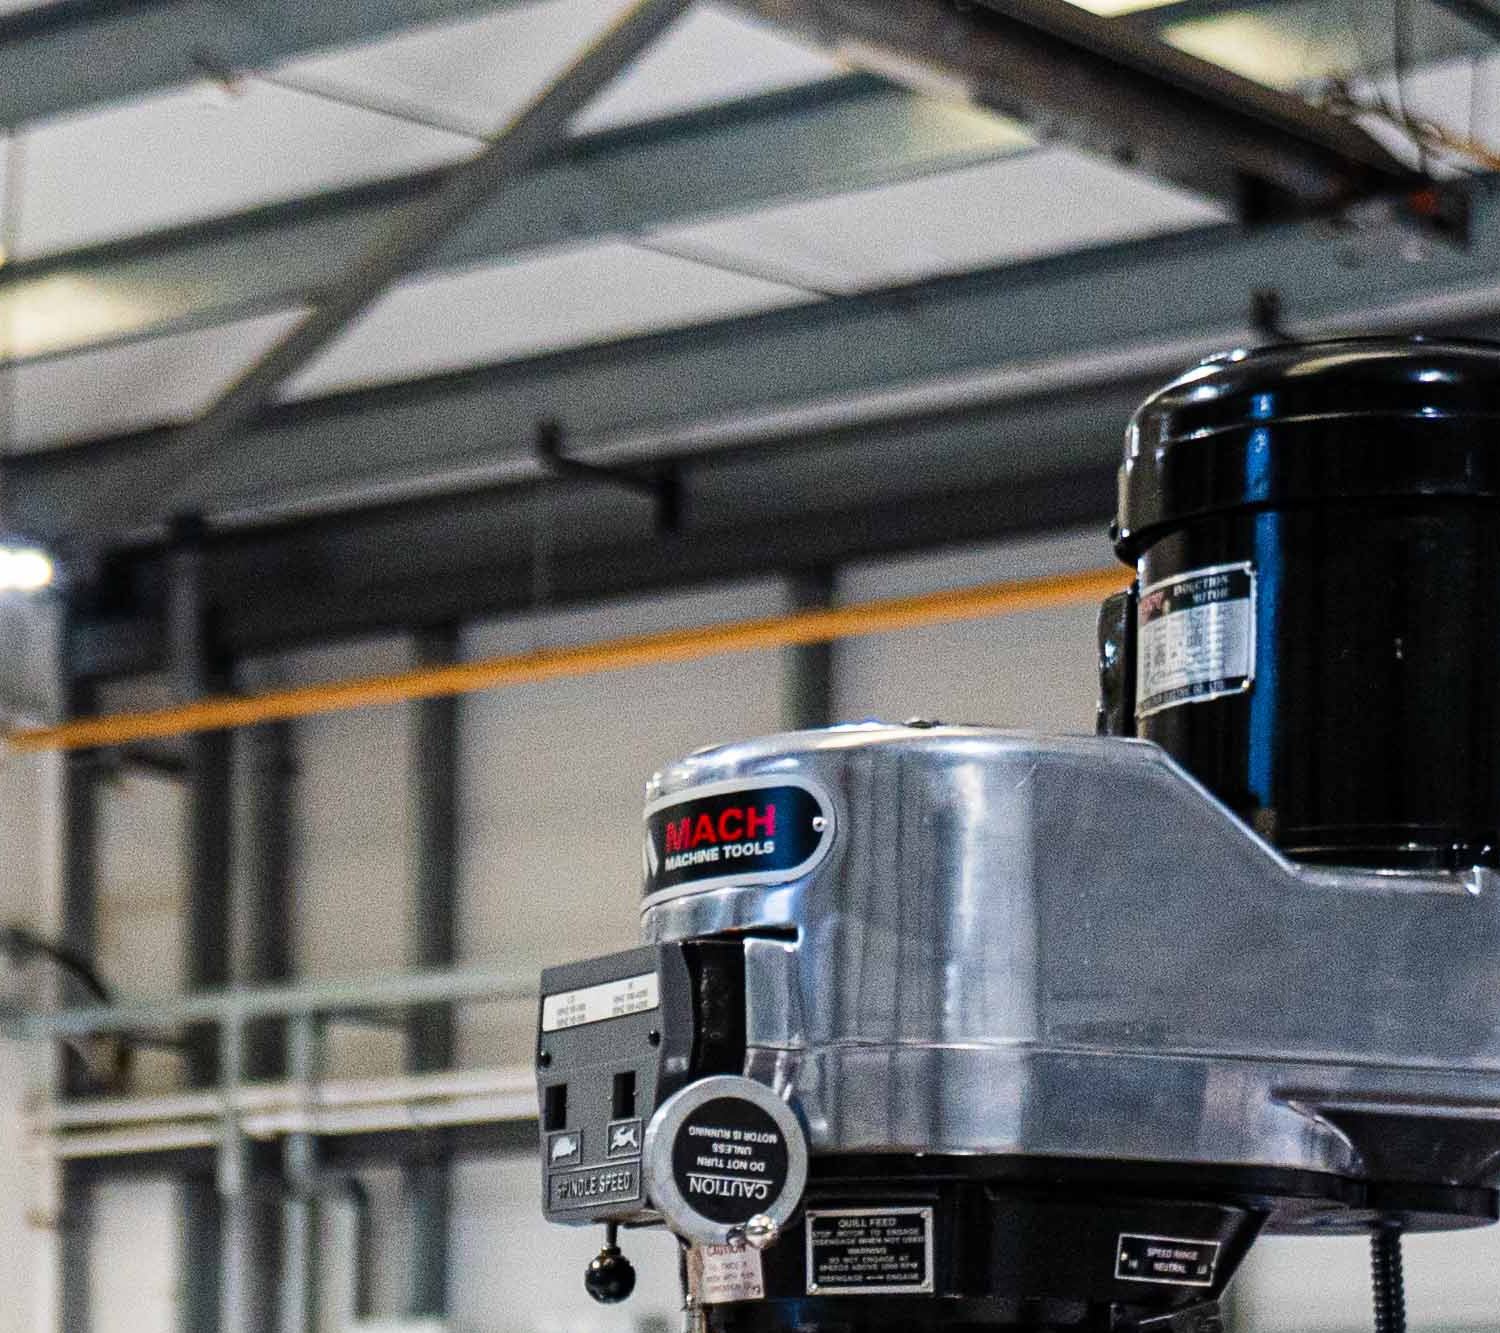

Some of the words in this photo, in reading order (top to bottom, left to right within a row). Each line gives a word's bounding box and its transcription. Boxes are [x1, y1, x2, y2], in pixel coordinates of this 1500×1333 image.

[665, 804, 776, 852] MACH
[665, 845, 719, 871] MACHINE
[723, 841, 775, 859] TOOLS
[688, 1125, 730, 1139] RUNNING
[733, 1130, 741, 1139] IS
[744, 1132, 777, 1144] MOTOR
[712, 1142, 752, 1155] UNLESS
[697, 1156, 725, 1168] TURN
[726, 1159, 748, 1171] NOT
[750, 1161, 765, 1172] DO
[599, 1172, 632, 1193] SPEED
[690, 1177, 768, 1200] CAUTION
[838, 1219, 867, 1228] QUILL
[869, 1218, 897, 1227] FEED
